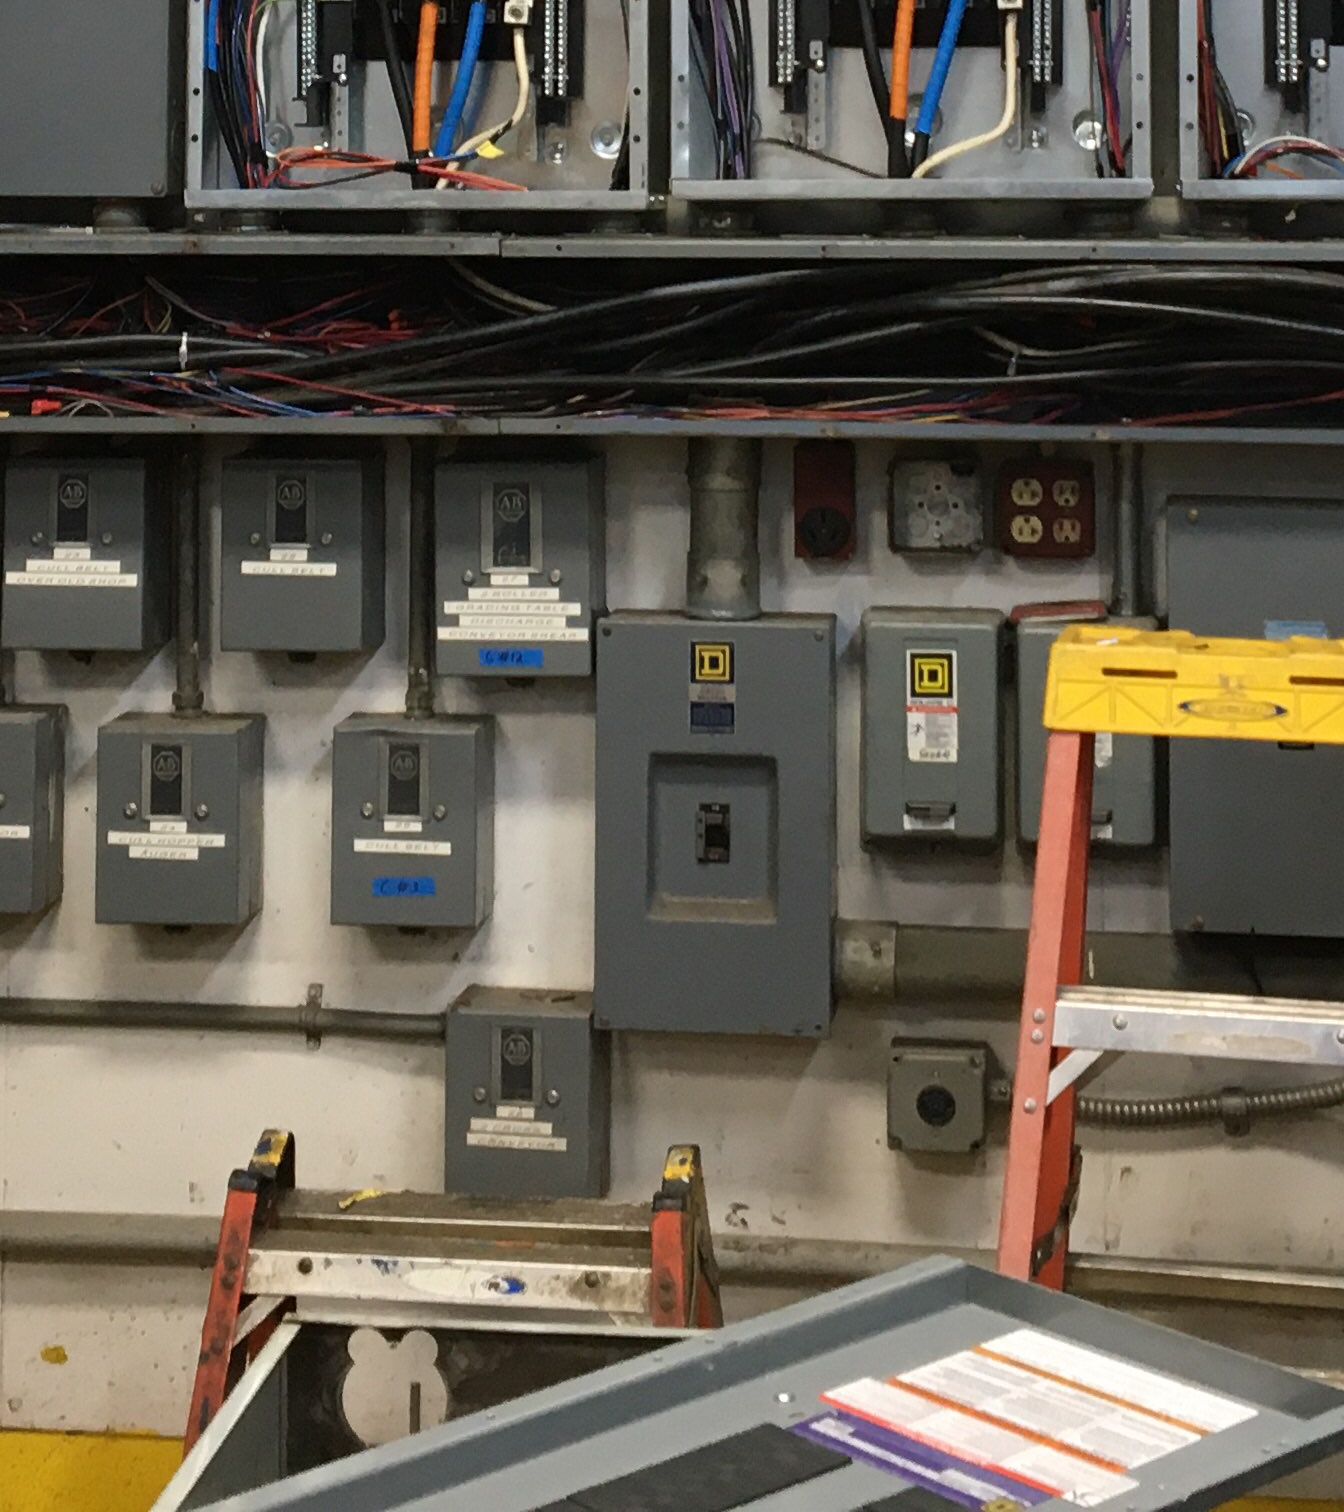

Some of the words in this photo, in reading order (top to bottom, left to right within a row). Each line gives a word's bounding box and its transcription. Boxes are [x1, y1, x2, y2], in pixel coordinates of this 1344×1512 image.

[456, 603, 521, 613] GRADING
[525, 603, 570, 613] TABLE
[469, 616, 554, 625] DISCHARGE
[448, 630, 526, 639] CONVEYOR
[157, 838, 215, 847] HOPPER
[141, 849, 187, 858] AUGER
